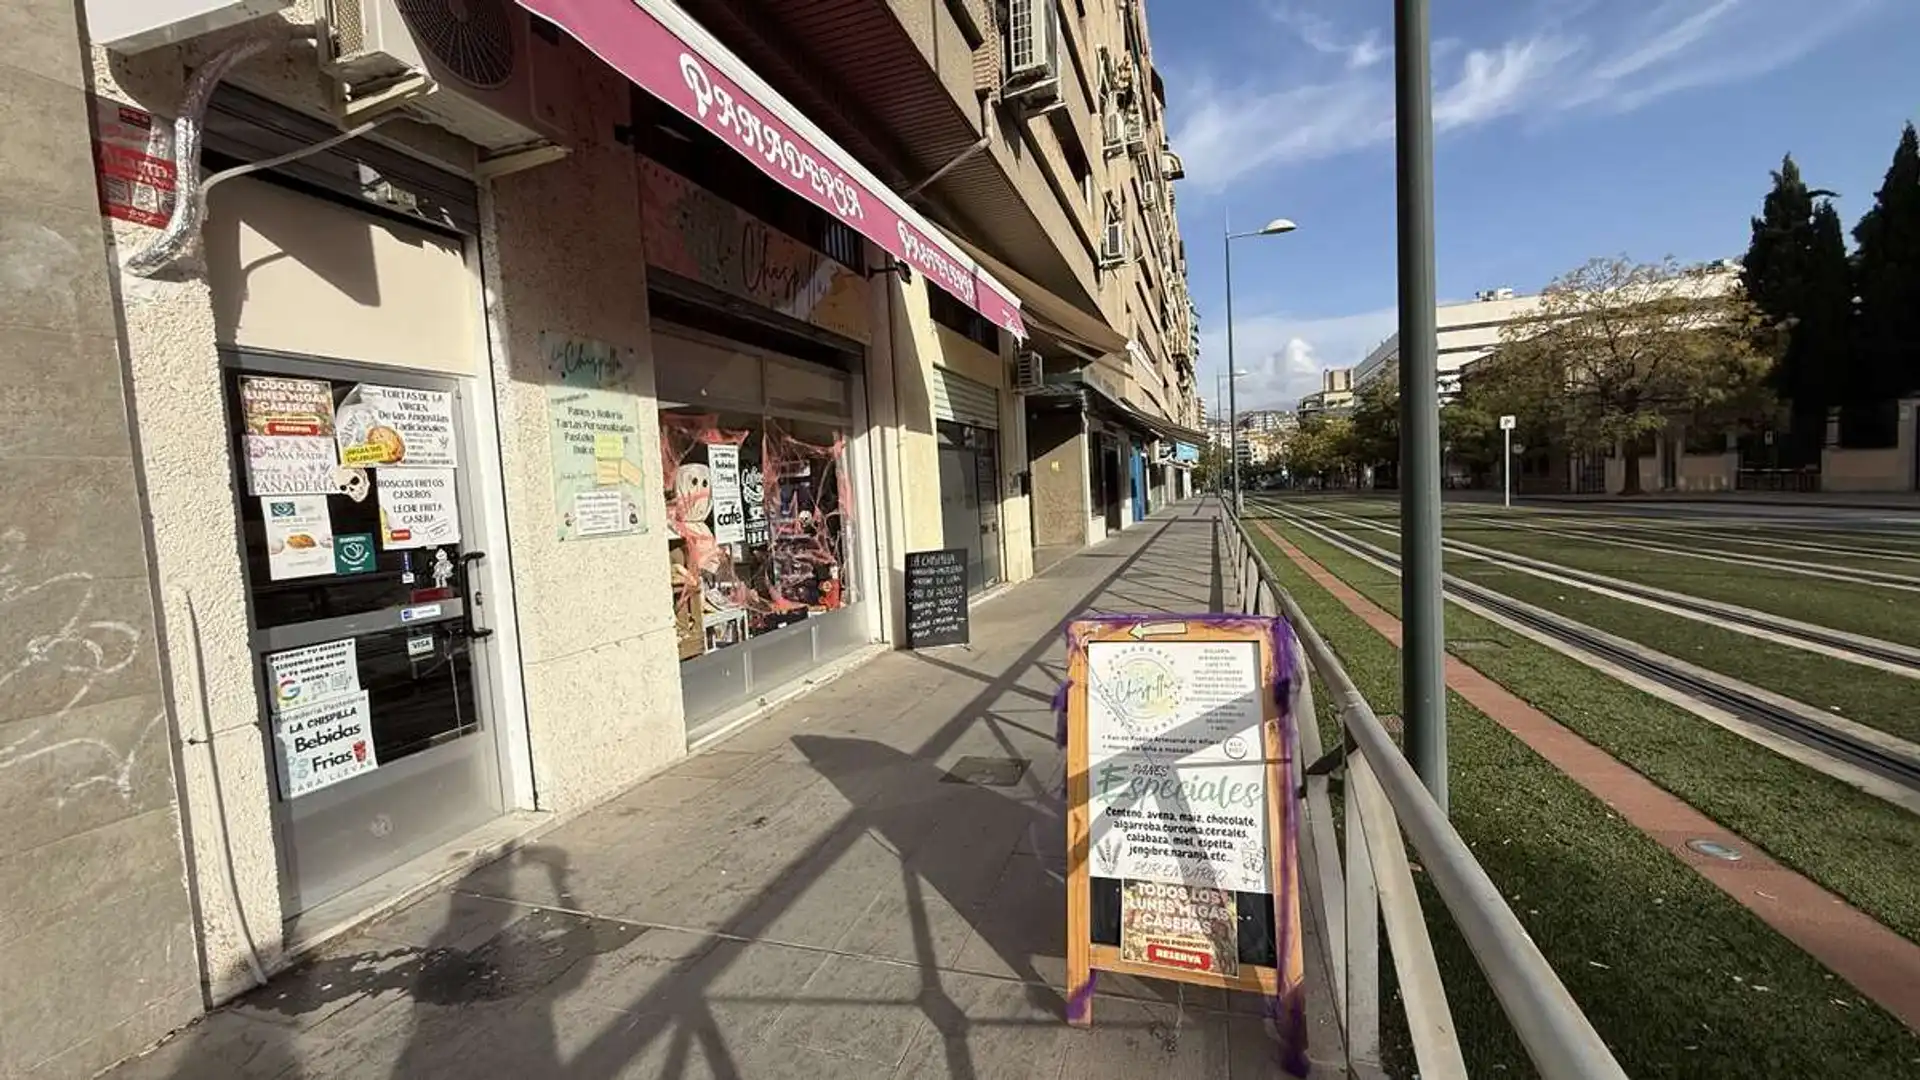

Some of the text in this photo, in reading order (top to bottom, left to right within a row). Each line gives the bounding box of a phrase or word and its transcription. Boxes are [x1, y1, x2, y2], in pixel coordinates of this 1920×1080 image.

[679, 53, 864, 219] PANADERÍA
[410, 640, 432, 650] VISA
[289, 706, 358, 735] LA CHISPILLA
[294, 723, 362, 753] Bebidas
[1096, 762, 1264, 809] Especiales
[1137, 883, 1223, 905] TODOS LOS
[1129, 898, 1230, 921] LUNES MIGAS
[1142, 913, 1213, 935] CASERAS
[1154, 948, 1203, 964] RESERVA
